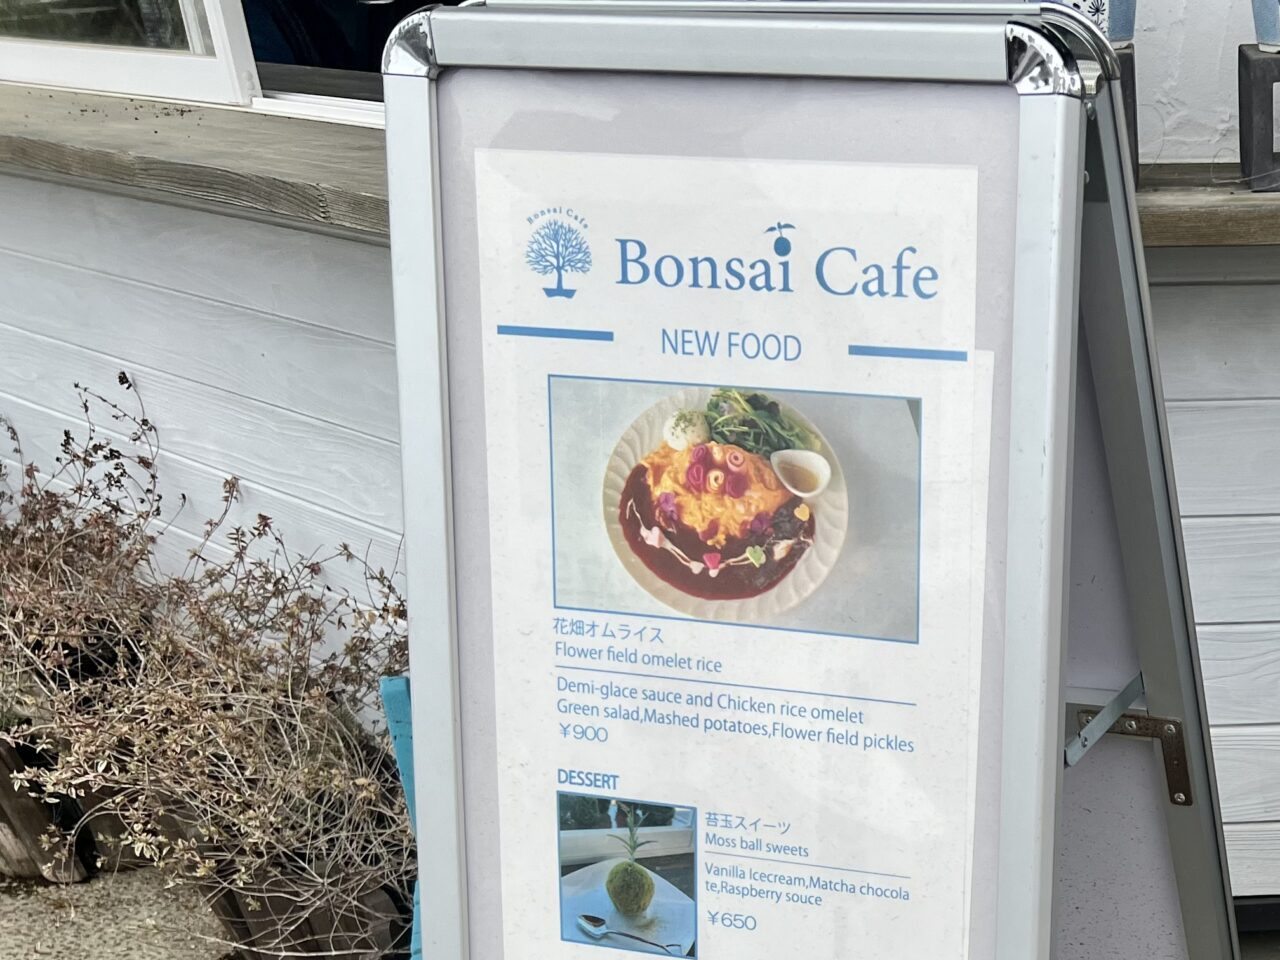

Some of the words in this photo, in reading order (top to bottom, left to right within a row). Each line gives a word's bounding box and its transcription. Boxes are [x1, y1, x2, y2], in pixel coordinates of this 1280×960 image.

[615, 236, 794, 294] Bonsai
[815, 246, 939, 300] Cafe
[661, 328, 720, 357] NEW
[727, 332, 802, 362] FOOD
[552, 618, 664, 643] 花畑オムライス
[555, 642, 603, 660] Flower
[606, 646, 638, 664] field
[642, 651, 693, 670] omelet
[696, 655, 722, 673] rice
[557, 676, 638, 700] Demi-glace
[642, 688, 682, 705] sauce
[686, 690, 713, 708] and
[717, 694, 775, 715] Chicken
[780, 700, 807, 719] rice
[810, 705, 864, 725] omelet
[556, 699, 600, 718] Green
[826, 727, 859, 747] field
[863, 733, 914, 753] pickles
[559, 723, 609, 743] ¥900
[557, 769, 619, 790] DESSERT
[705, 811, 791, 835] 苔玉スイーツ
[705, 832, 737, 850] Moss
[740, 835, 762, 853] ball
[765, 840, 809, 858] sweets
[705, 862, 746, 880] Vanilla
[859, 881, 910, 901] chocola
[785, 891, 823, 907] souce
[707, 911, 757, 931] ¥650
